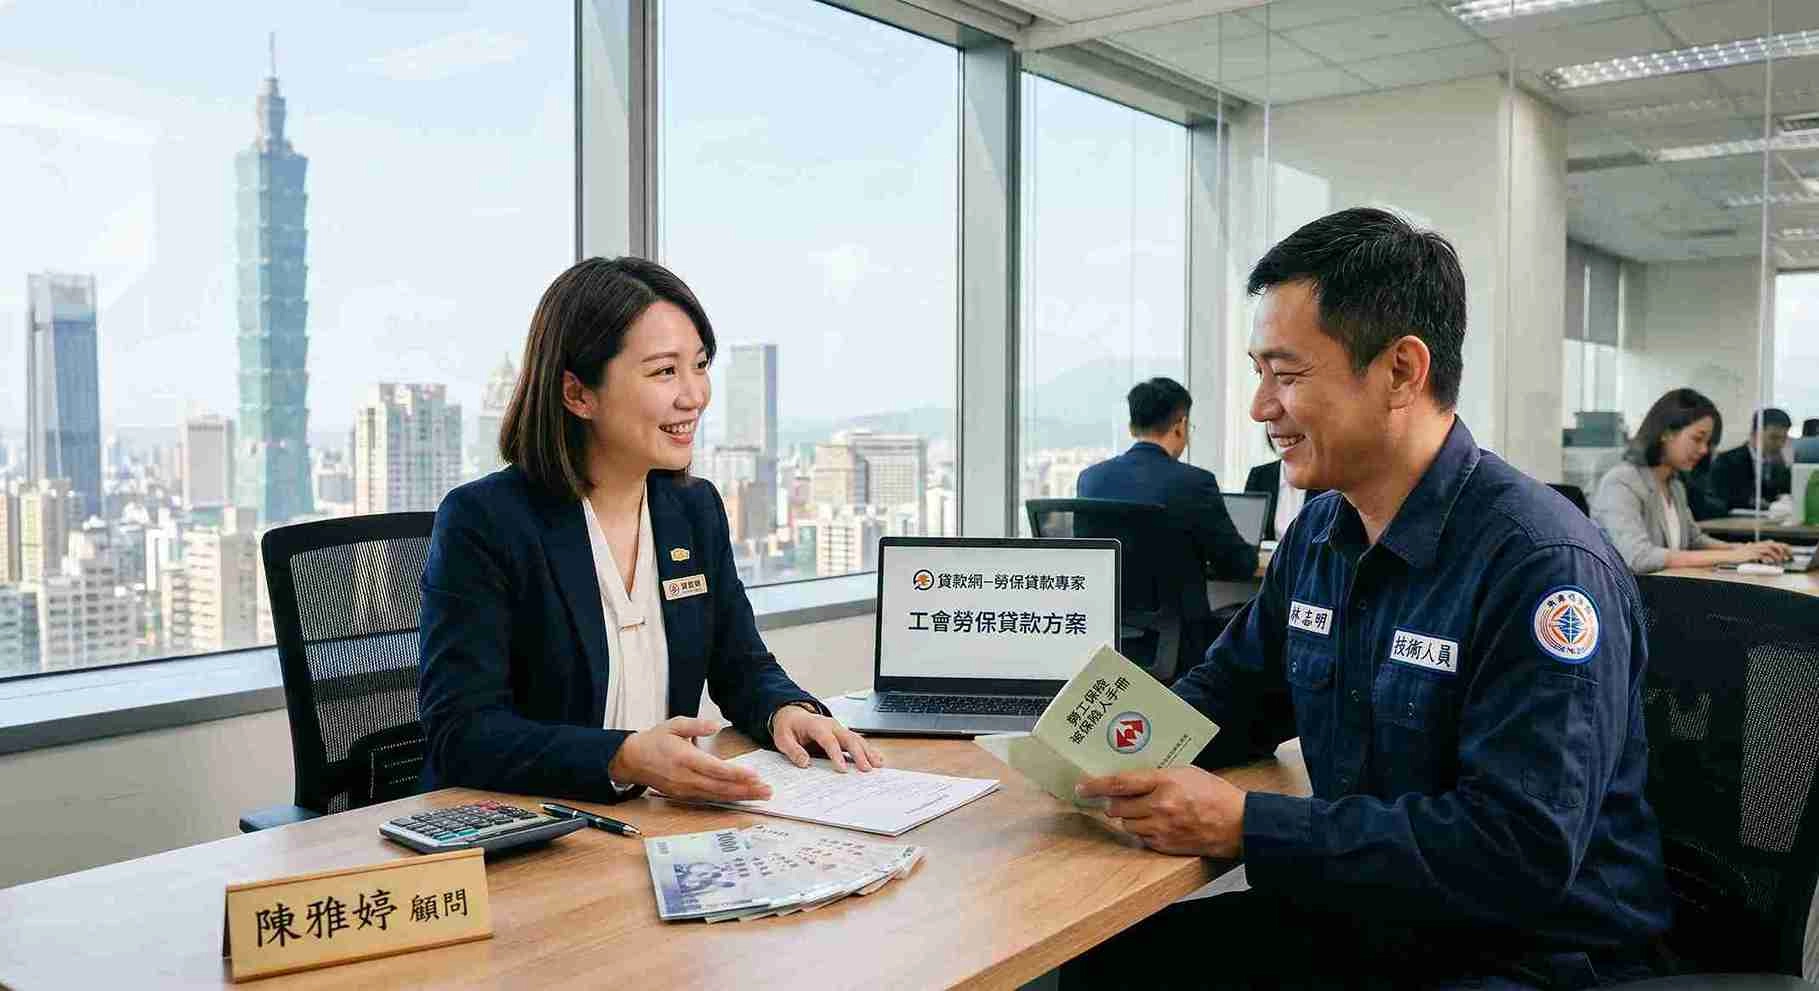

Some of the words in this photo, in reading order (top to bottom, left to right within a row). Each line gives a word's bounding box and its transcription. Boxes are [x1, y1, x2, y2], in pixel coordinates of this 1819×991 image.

[908, 610, 1087, 635] 工會勞保貸款方案
[1393, 635, 1450, 667] 技術人員
[1066, 678, 1109, 727] 勞工保險
[1070, 677, 1131, 744] 被保險人手冊
[256, 889, 398, 948] 陳雅婷
[409, 888, 469, 923] 顧問
